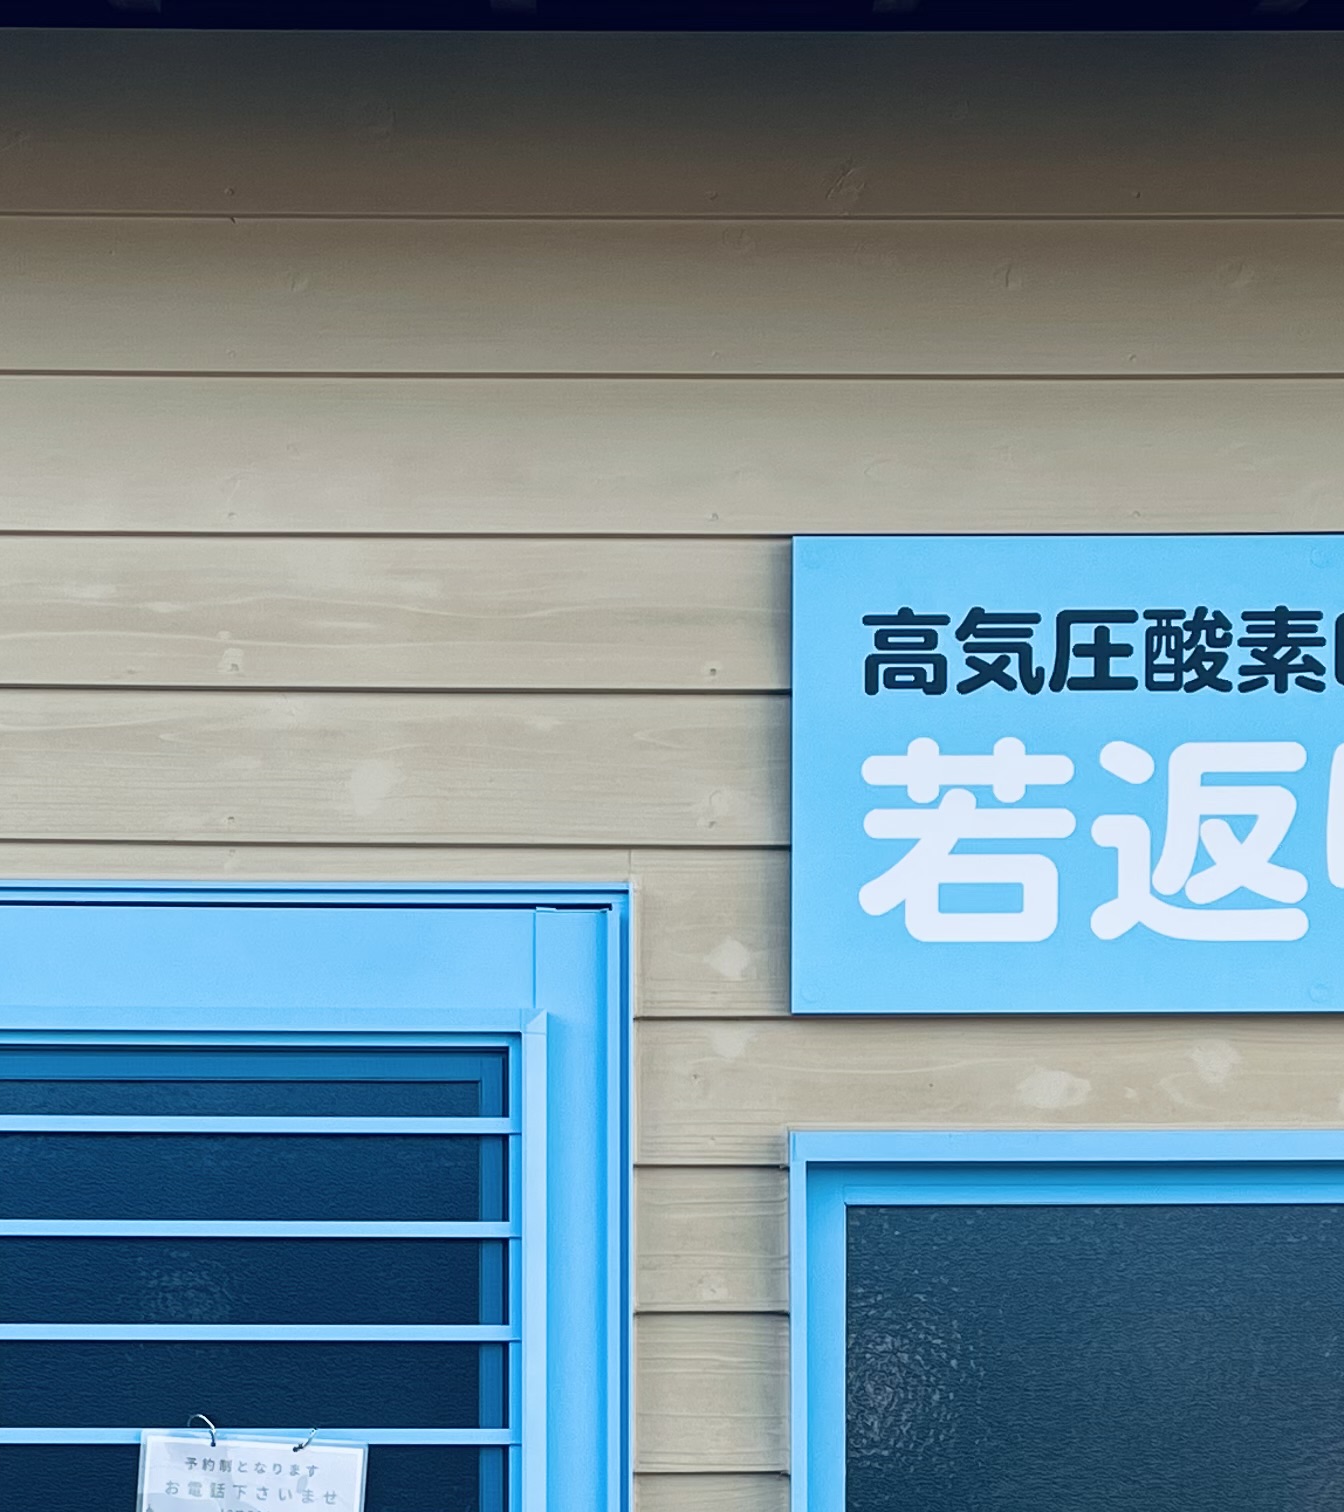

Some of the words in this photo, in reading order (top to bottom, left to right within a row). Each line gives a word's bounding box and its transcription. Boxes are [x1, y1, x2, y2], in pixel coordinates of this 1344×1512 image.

[184, 1456, 319, 1478] 予約制となります
[164, 1480, 338, 1505] お電話下さいませ
